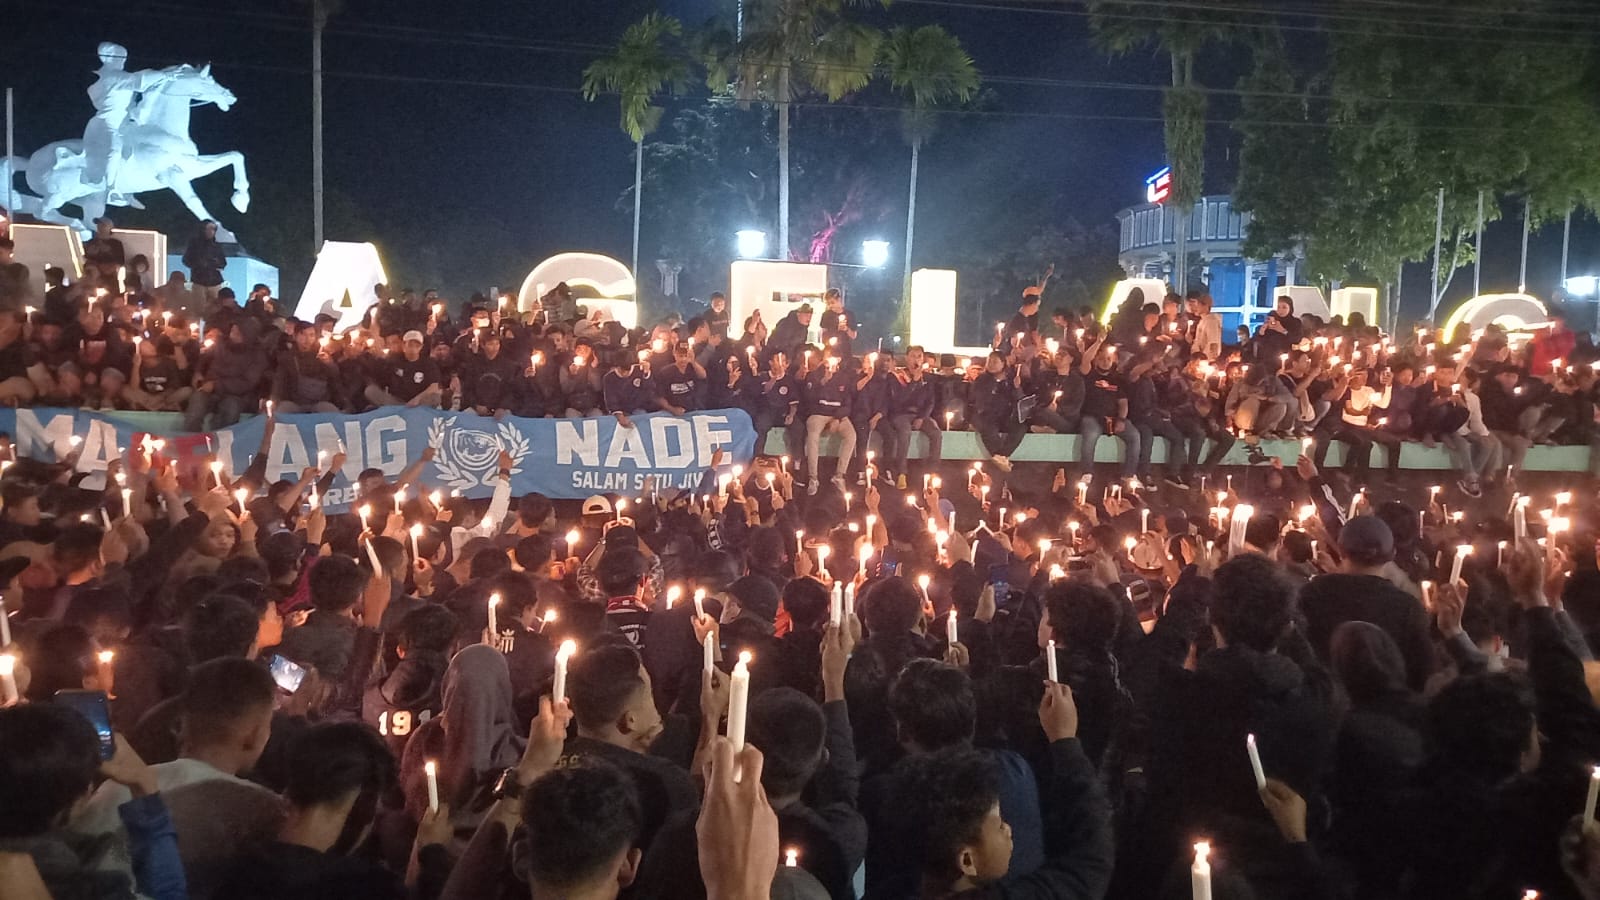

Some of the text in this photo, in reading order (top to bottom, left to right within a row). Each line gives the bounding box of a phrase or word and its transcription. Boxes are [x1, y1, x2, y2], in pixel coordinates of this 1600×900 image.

[555, 415, 733, 469] NADE
[572, 470, 628, 490] SALAM
[678, 472, 712, 492] JI
